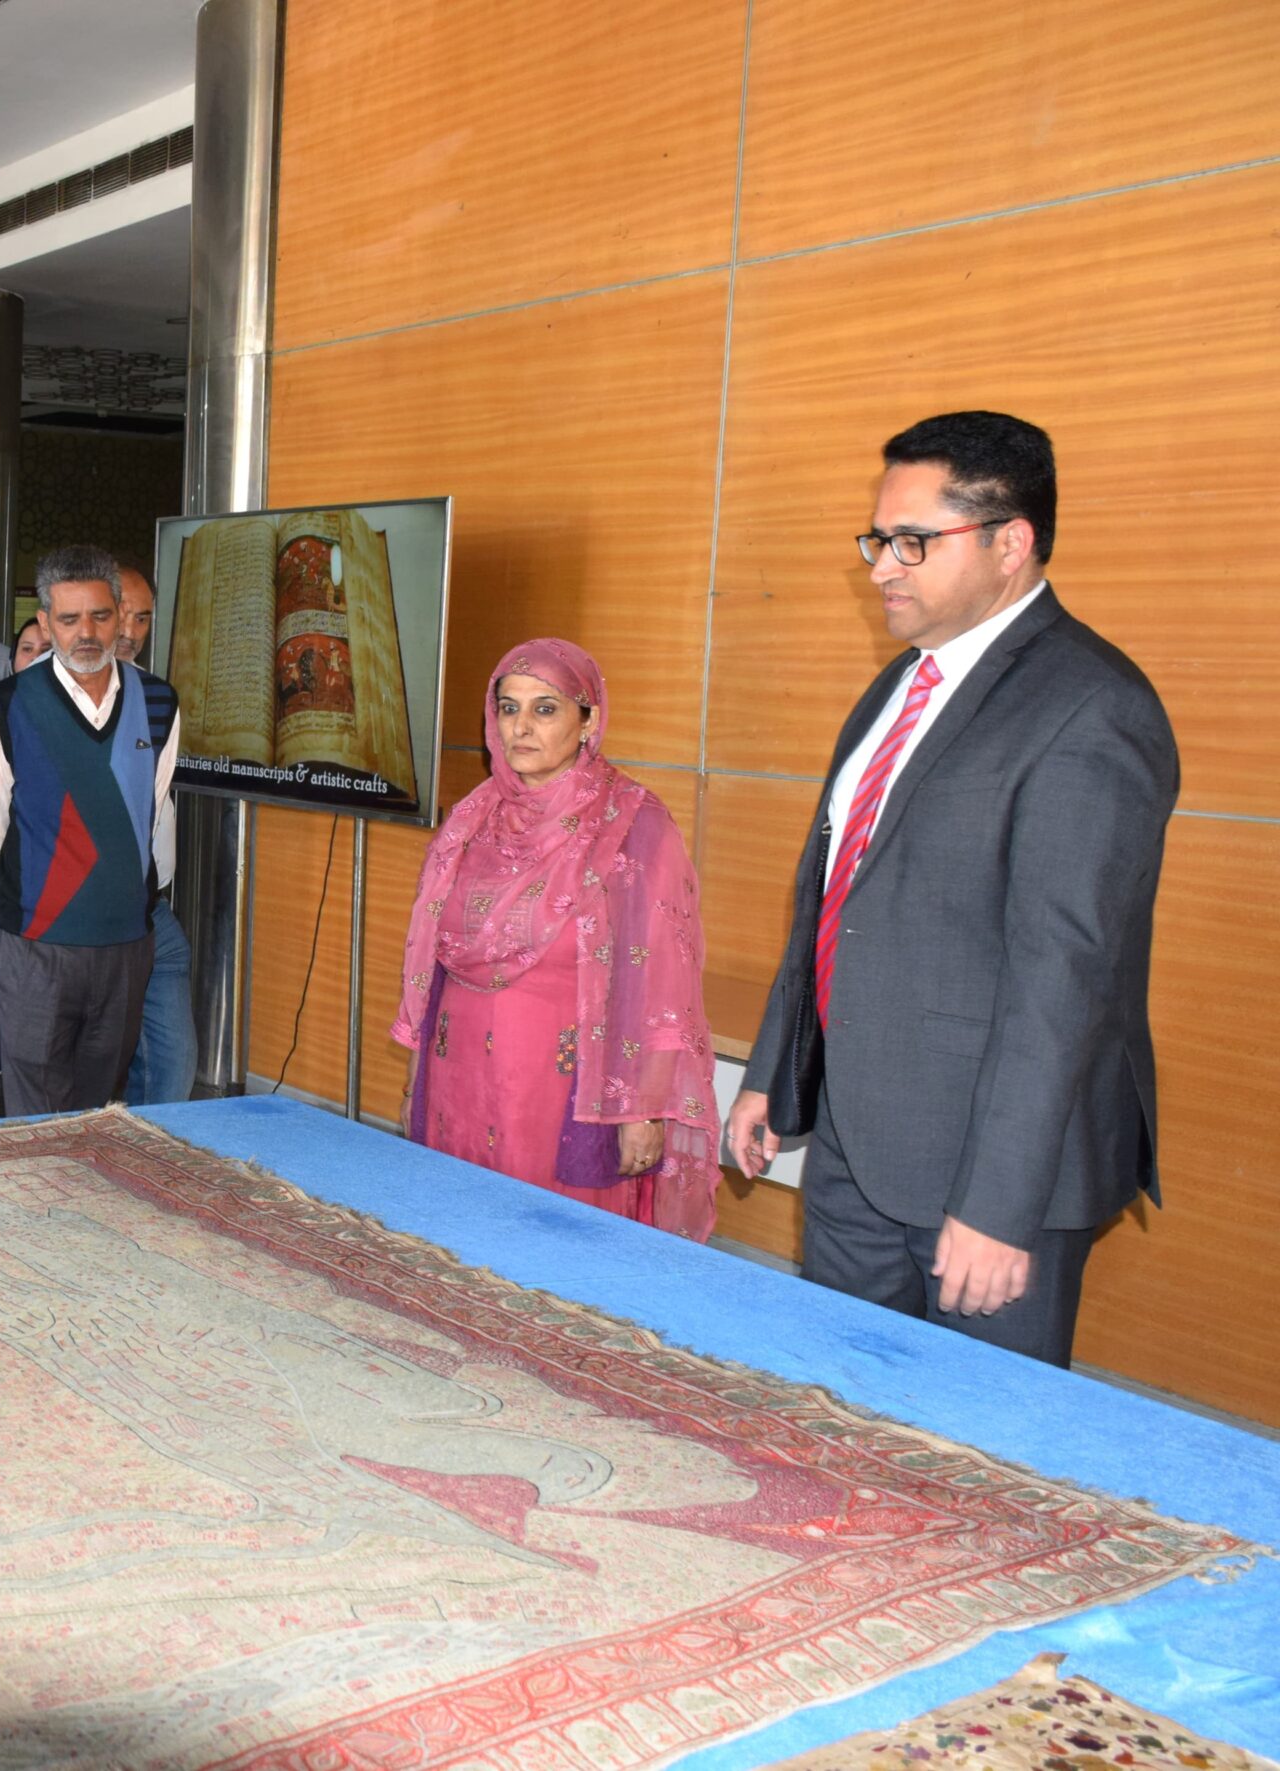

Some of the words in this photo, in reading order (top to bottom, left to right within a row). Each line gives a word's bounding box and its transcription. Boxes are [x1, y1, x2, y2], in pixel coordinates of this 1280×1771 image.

[175, 755, 212, 771] enturies
[213, 755, 230, 773] old
[231, 764, 294, 784] manuscripts
[296, 763, 310, 783] &
[310, 770, 352, 789] artistic
[353, 773, 388, 794] crafts
